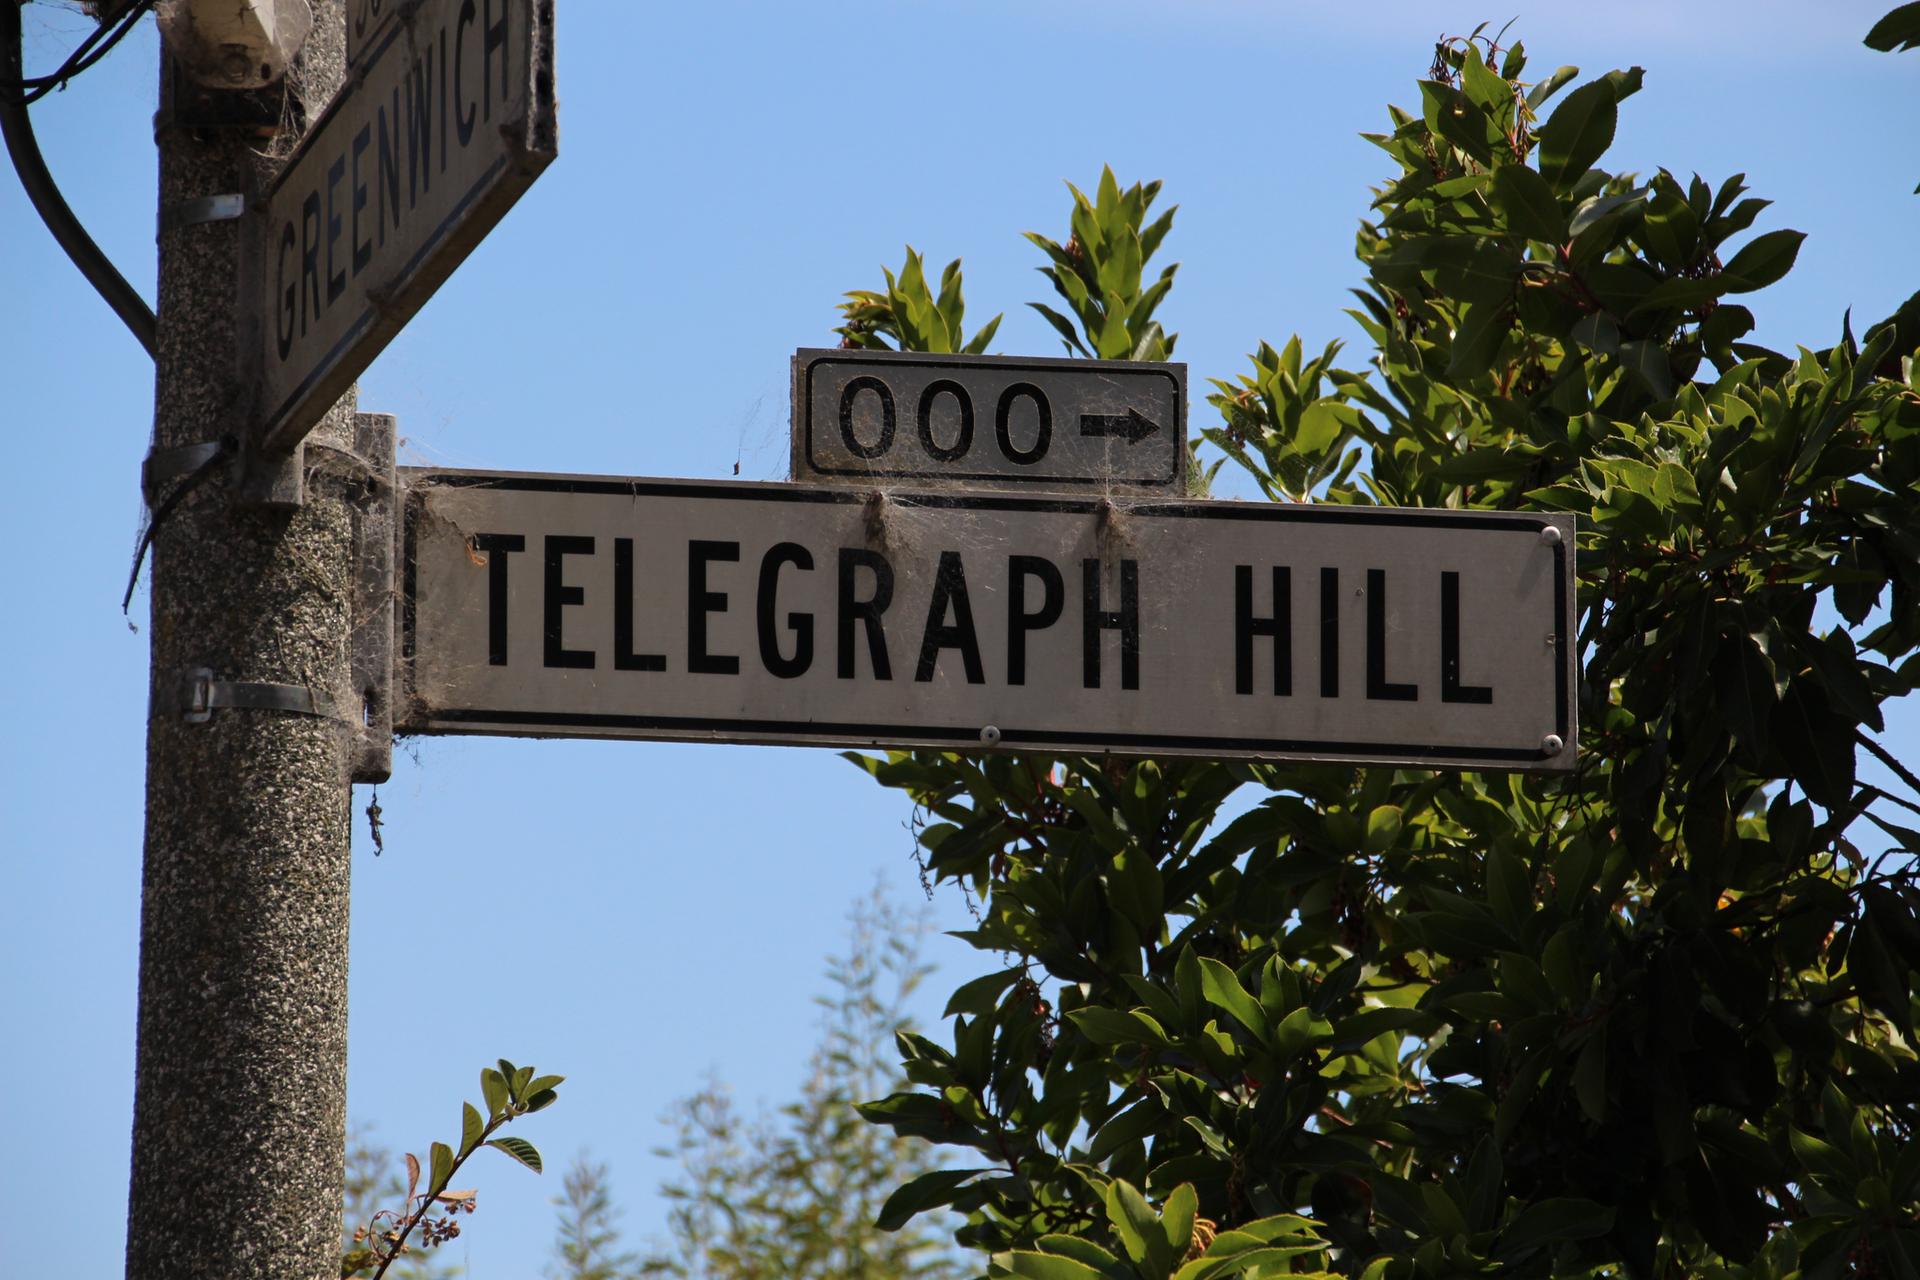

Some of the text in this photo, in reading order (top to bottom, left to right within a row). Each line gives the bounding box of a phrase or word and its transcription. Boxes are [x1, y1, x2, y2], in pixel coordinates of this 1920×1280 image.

[276, 0, 509, 362] GREENWICH
[838, 375, 1053, 466] 000
[472, 532, 1493, 704] TELEGRAPH HILL
